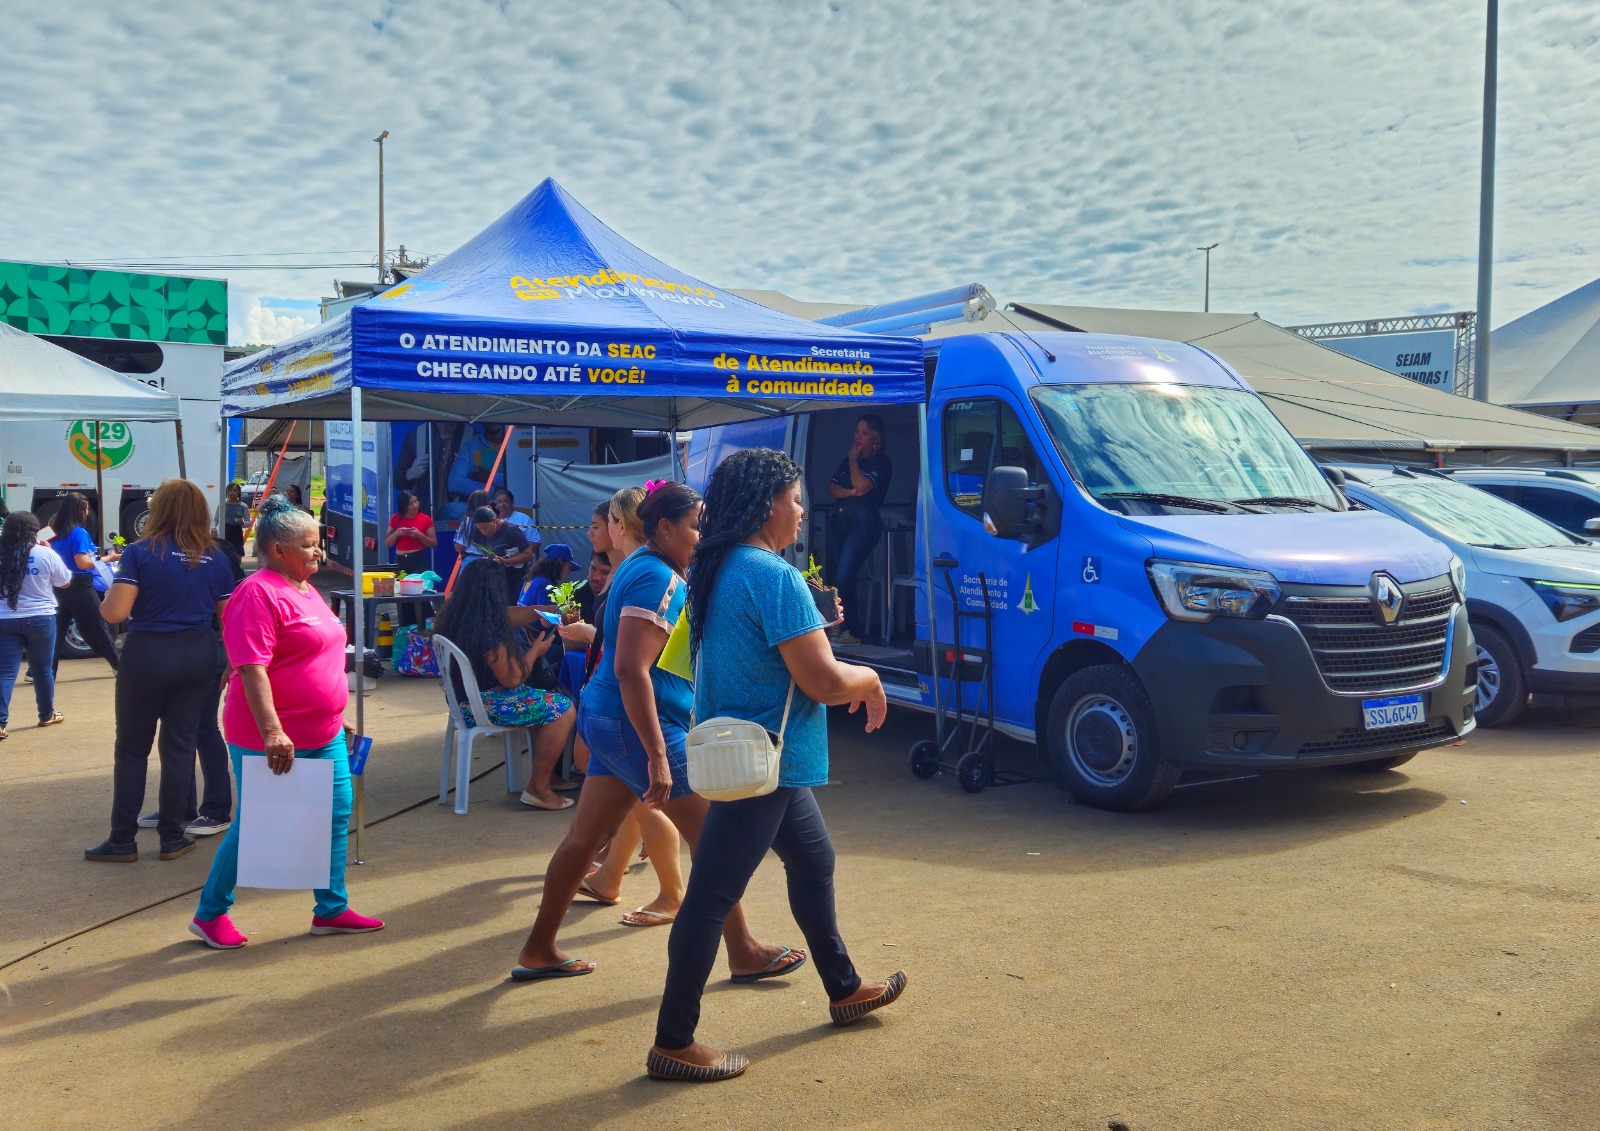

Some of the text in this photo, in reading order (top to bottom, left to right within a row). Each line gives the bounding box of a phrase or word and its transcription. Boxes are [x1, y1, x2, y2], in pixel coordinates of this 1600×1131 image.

[510, 269, 716, 299] Atendimento
[565, 285, 726, 309] Movimento
[399, 332, 656, 360] O ATENDIMENTO DA SEAC
[810, 345, 870, 359] Secretaria
[712, 352, 875, 375] de Atendimento
[1395, 352, 1432, 367] SEJAM
[416, 360, 646, 384] CHEGANDO ATÉ VOCÊ!
[726, 374, 874, 397] à comunidade
[86, 422, 126, 440] 129
[963, 574, 1008, 587] Secrearia de
[1002, 589, 1008, 598] à
[1369, 704, 1418, 726] SSL6C49
